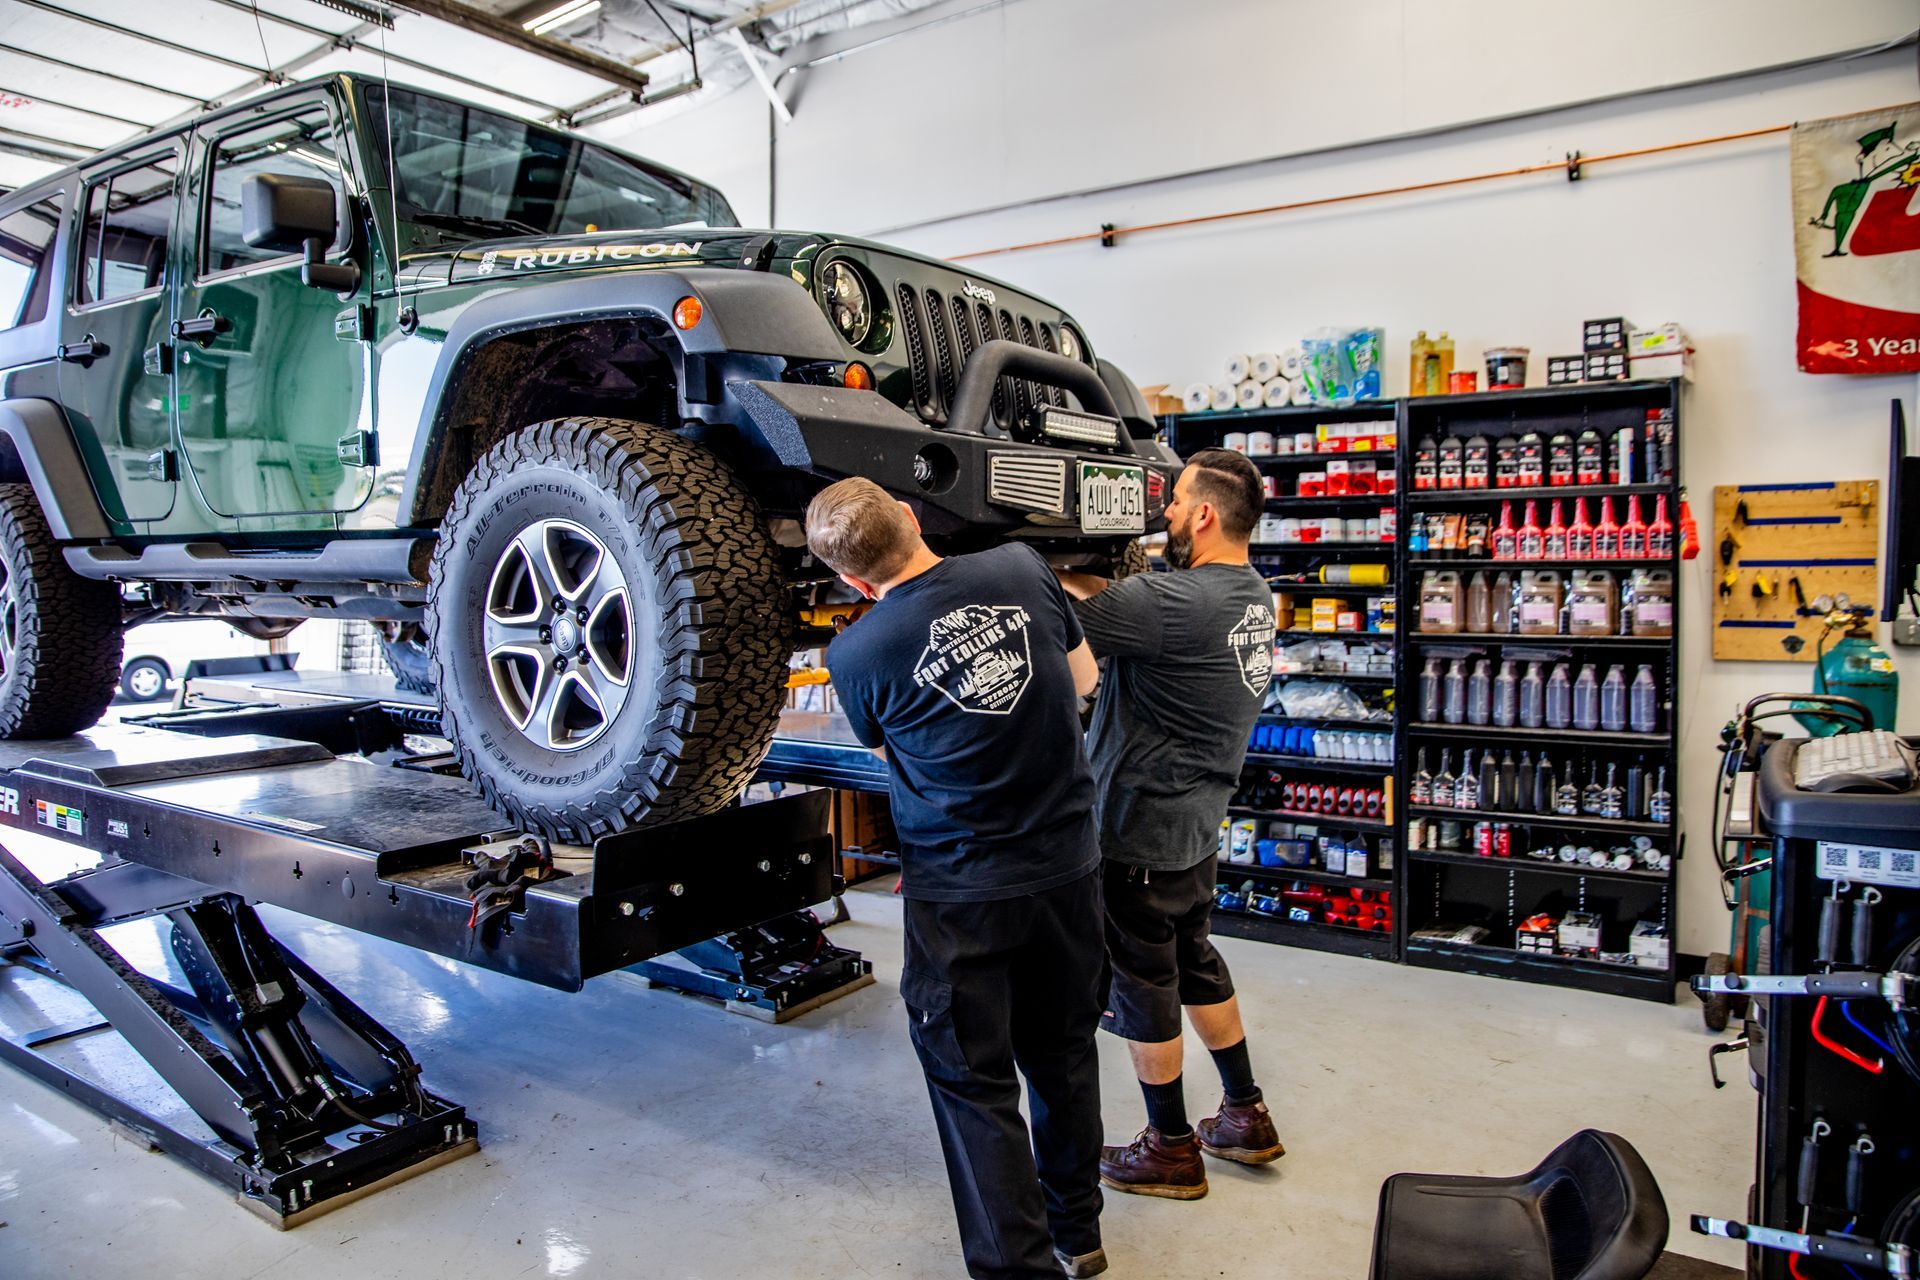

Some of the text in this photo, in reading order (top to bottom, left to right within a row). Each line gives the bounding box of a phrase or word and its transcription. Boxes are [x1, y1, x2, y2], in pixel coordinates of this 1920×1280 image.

[513, 242, 703, 270] RUBICON
[963, 280, 996, 305] Jeep
[1843, 337, 1920, 358] 3 Yea
[467, 483, 587, 560] All-Terrain
[1099, 517, 1130, 527] COLORADO
[938, 617, 999, 655] NORTHERN COLORADO
[1227, 632, 1249, 647] FORT
[913, 656, 950, 688] FORT
[951, 624, 1007, 665] COLLINS
[479, 731, 616, 786] BFGoodrich
